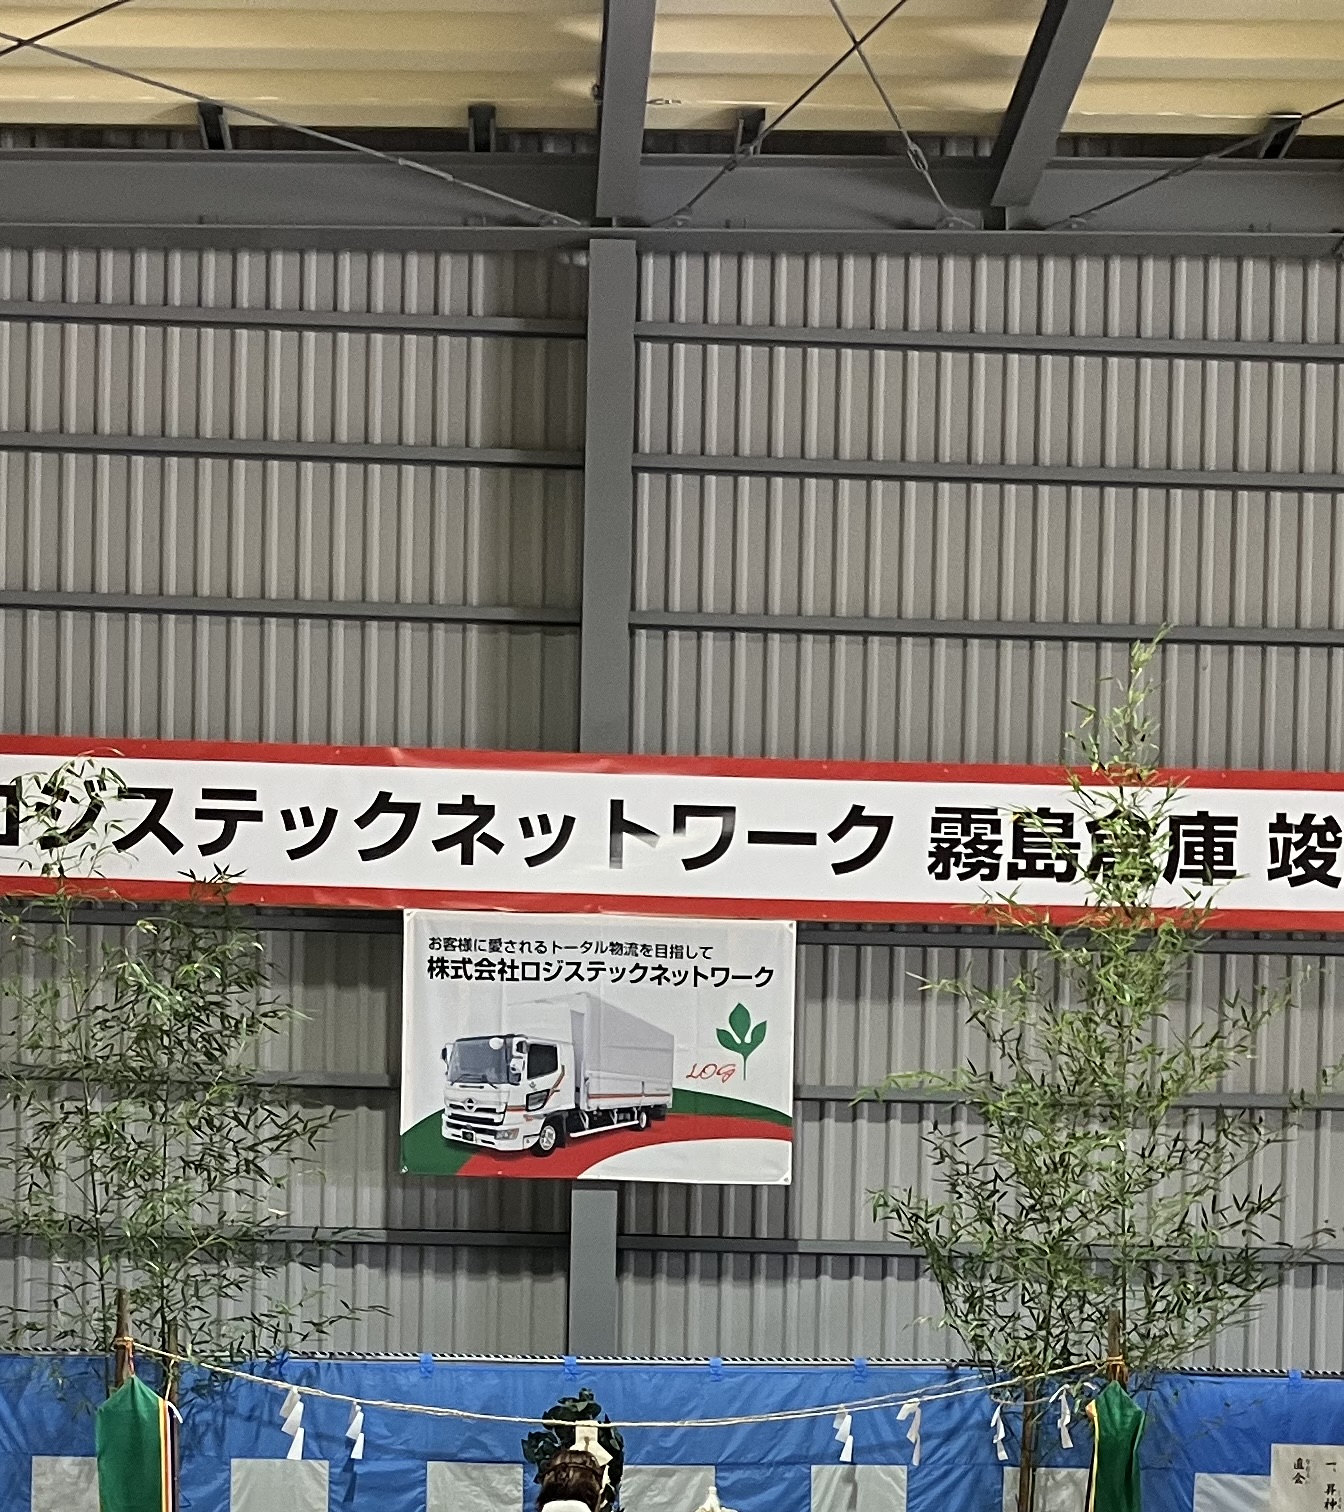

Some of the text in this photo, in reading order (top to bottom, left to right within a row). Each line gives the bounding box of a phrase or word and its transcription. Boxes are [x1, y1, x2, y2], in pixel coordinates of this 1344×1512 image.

[428, 937, 714, 961] お客様に愛されるトータル物流を目指して
[427, 956, 774, 988] 株式会社ロジステックネットワーク
